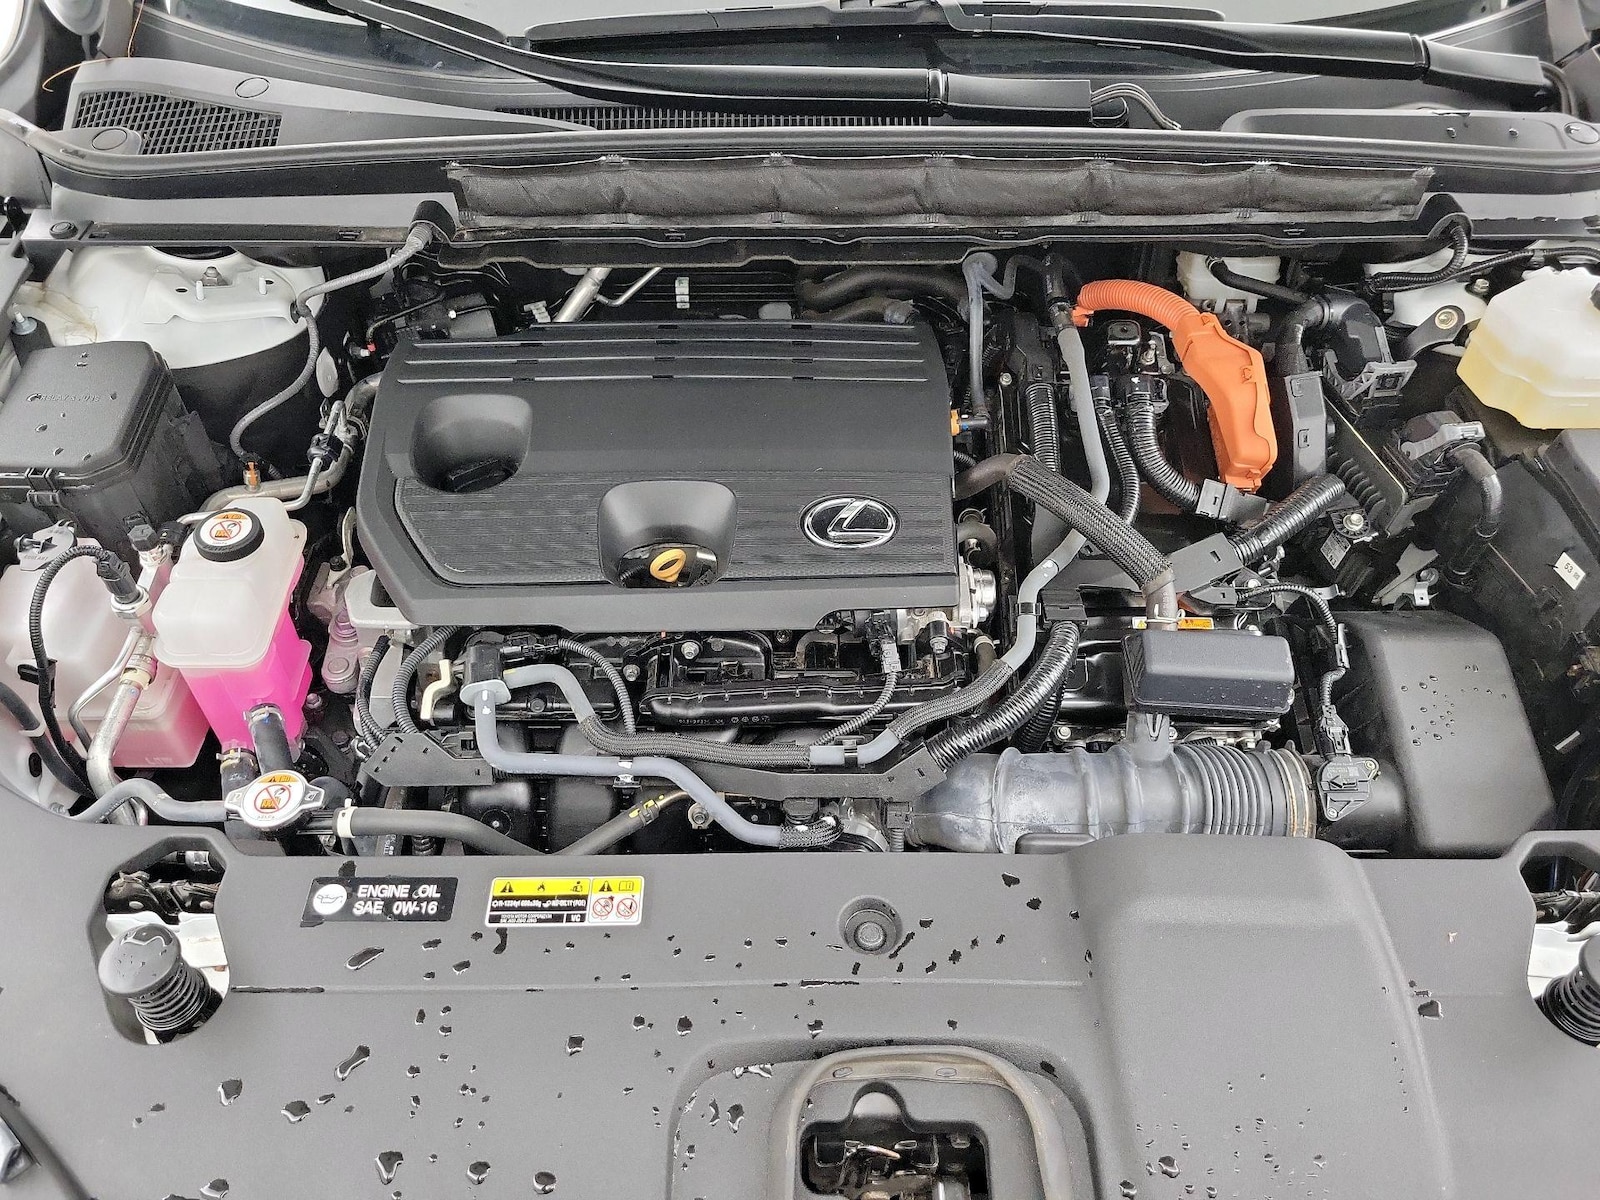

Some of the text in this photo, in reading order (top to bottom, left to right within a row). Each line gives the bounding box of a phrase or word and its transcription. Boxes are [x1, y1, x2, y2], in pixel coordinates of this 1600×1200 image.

[357, 884, 442, 899] ENGINE OIL
[352, 900, 438, 917] SAE 0W-16
